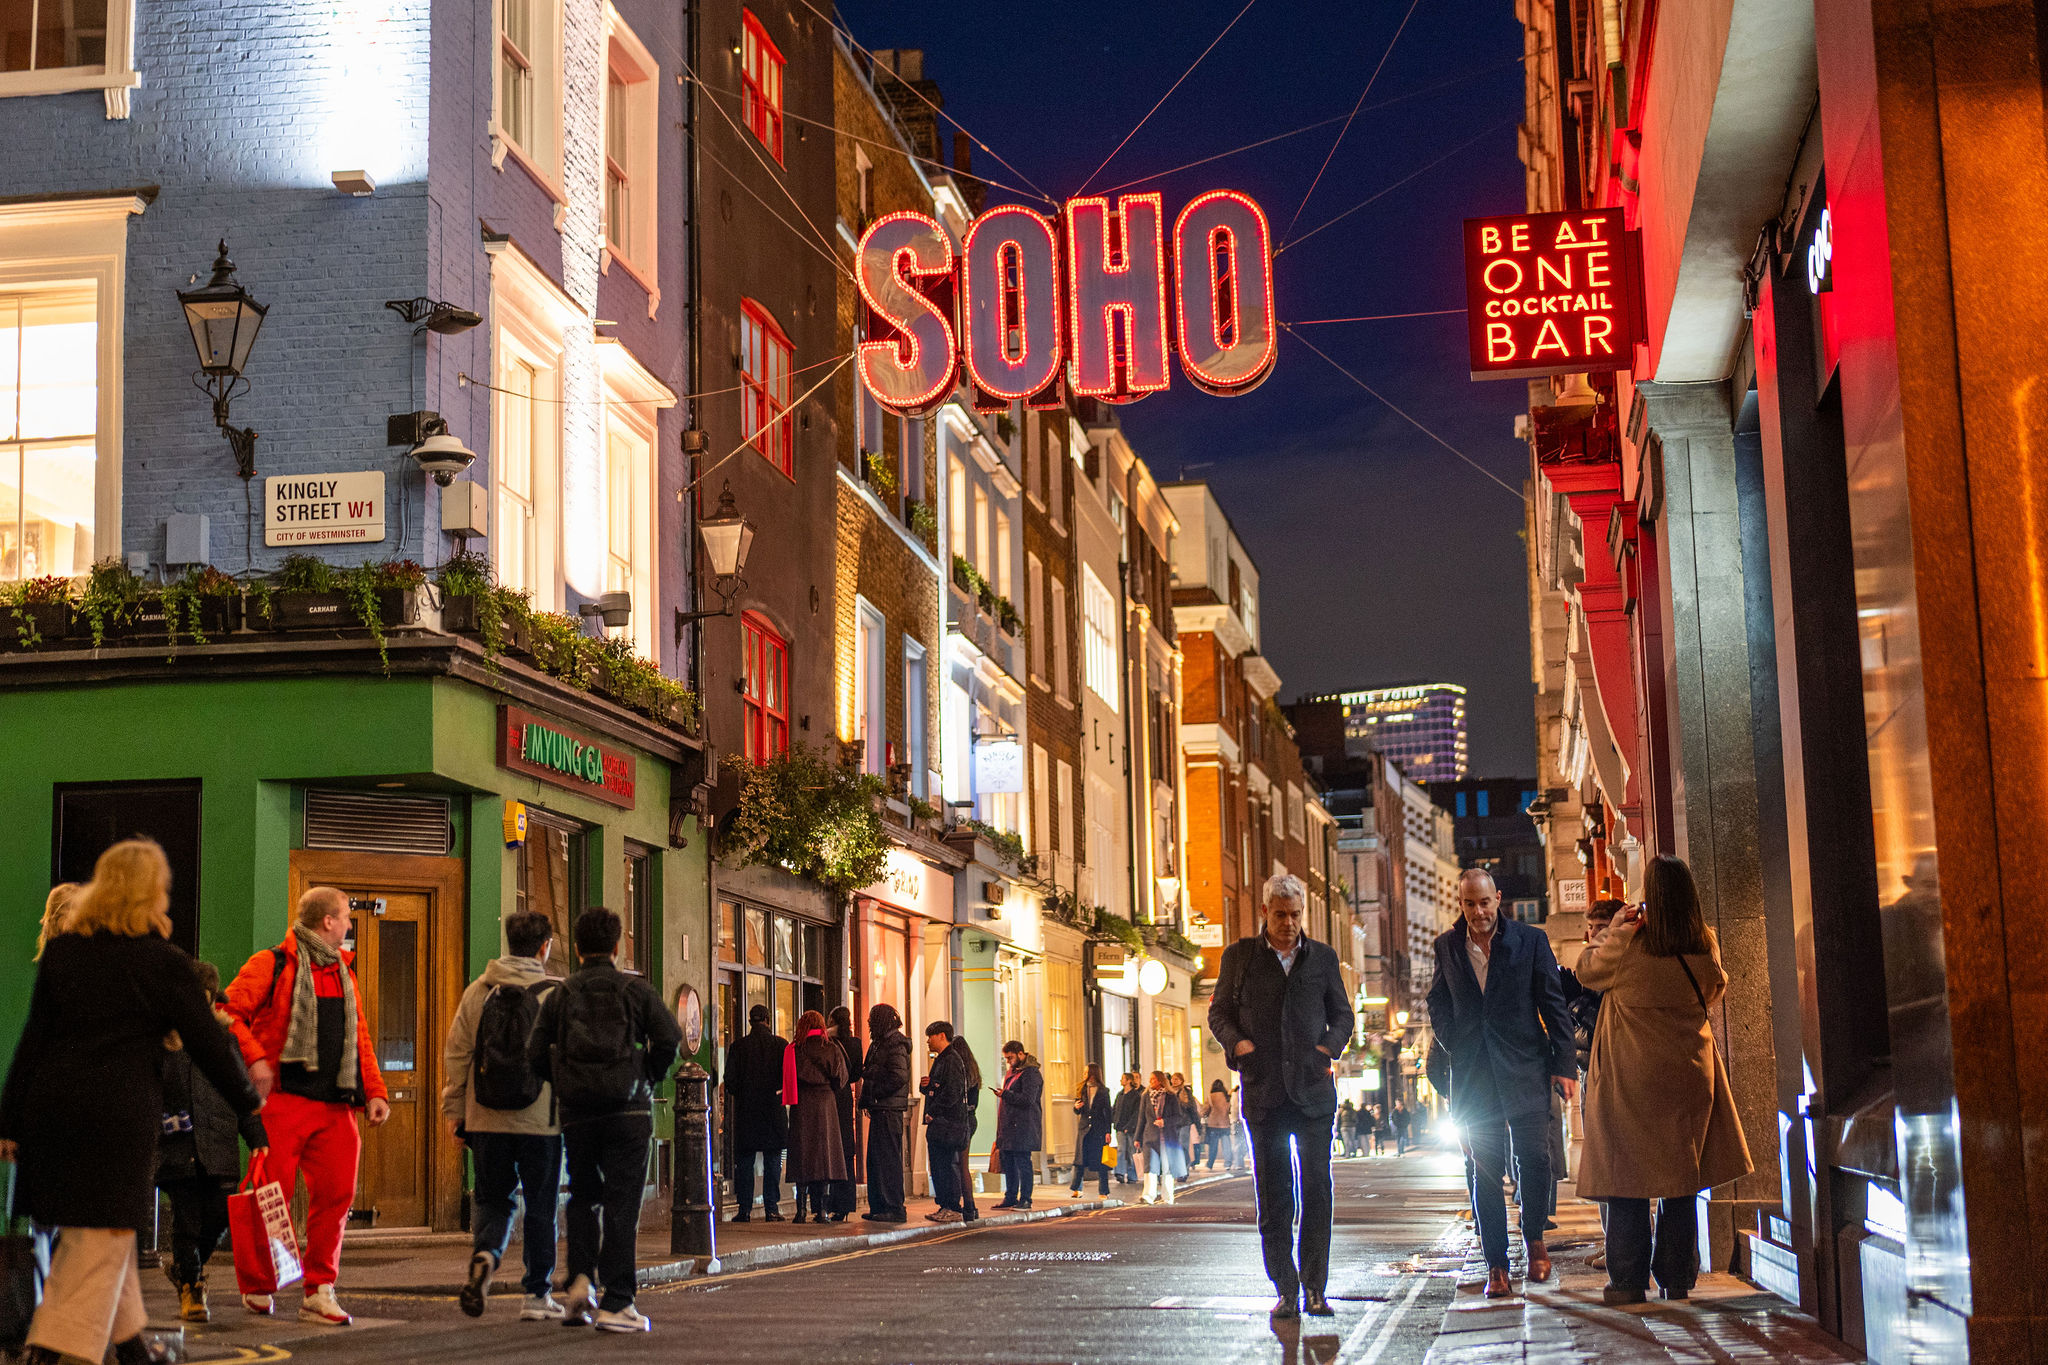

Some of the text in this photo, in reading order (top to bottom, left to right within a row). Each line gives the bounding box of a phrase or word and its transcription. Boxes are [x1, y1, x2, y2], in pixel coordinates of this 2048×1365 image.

[1482, 218, 1607, 253] BE AT
[1484, 251, 1611, 294] ONE
[856, 190, 1276, 405] SOHO
[1485, 293, 1612, 317] COCKTAIL
[1487, 316, 1613, 362] BAR
[277, 481, 338, 500] KINGLY
[276, 500, 373, 521] STREET W1
[276, 529, 366, 541] CITY OF WESTMINSTER
[309, 605, 338, 613] CARNABY
[1383, 688, 1425, 701] POINT
[529, 724, 581, 776] MYUNG
[583, 745, 605, 784] GA
[602, 772, 634, 798] STAURANT
[1564, 882, 1585, 891] UPPE
[1564, 892, 1585, 902] STRE
